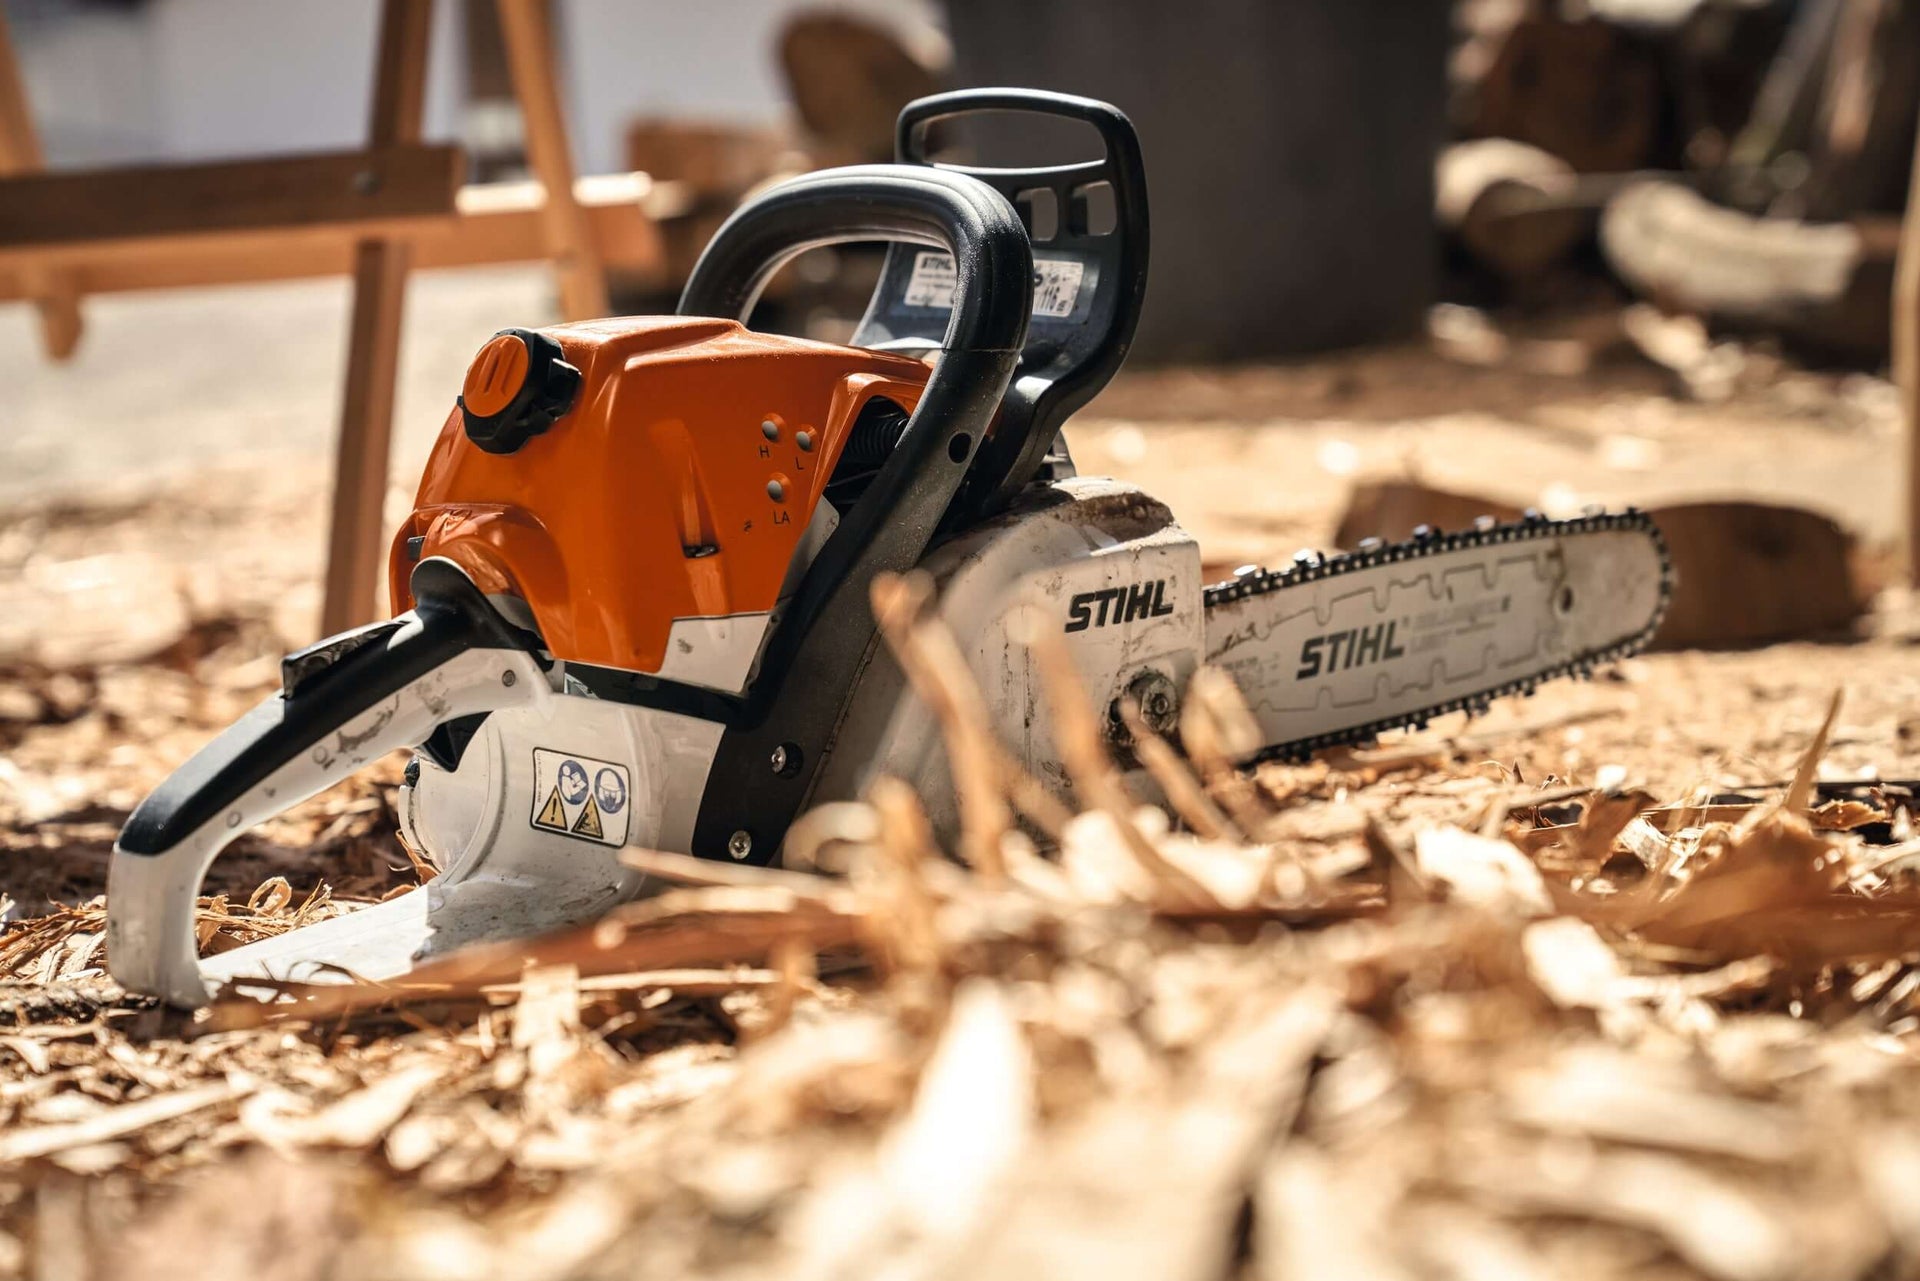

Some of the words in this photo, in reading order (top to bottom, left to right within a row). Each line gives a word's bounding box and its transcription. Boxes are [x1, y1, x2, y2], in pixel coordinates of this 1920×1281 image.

[759, 446, 770, 458] H
[795, 456, 804, 470] L
[773, 511, 790, 524] LA
[1064, 579, 1174, 633] STIHL
[1296, 620, 1404, 680] STIHL
